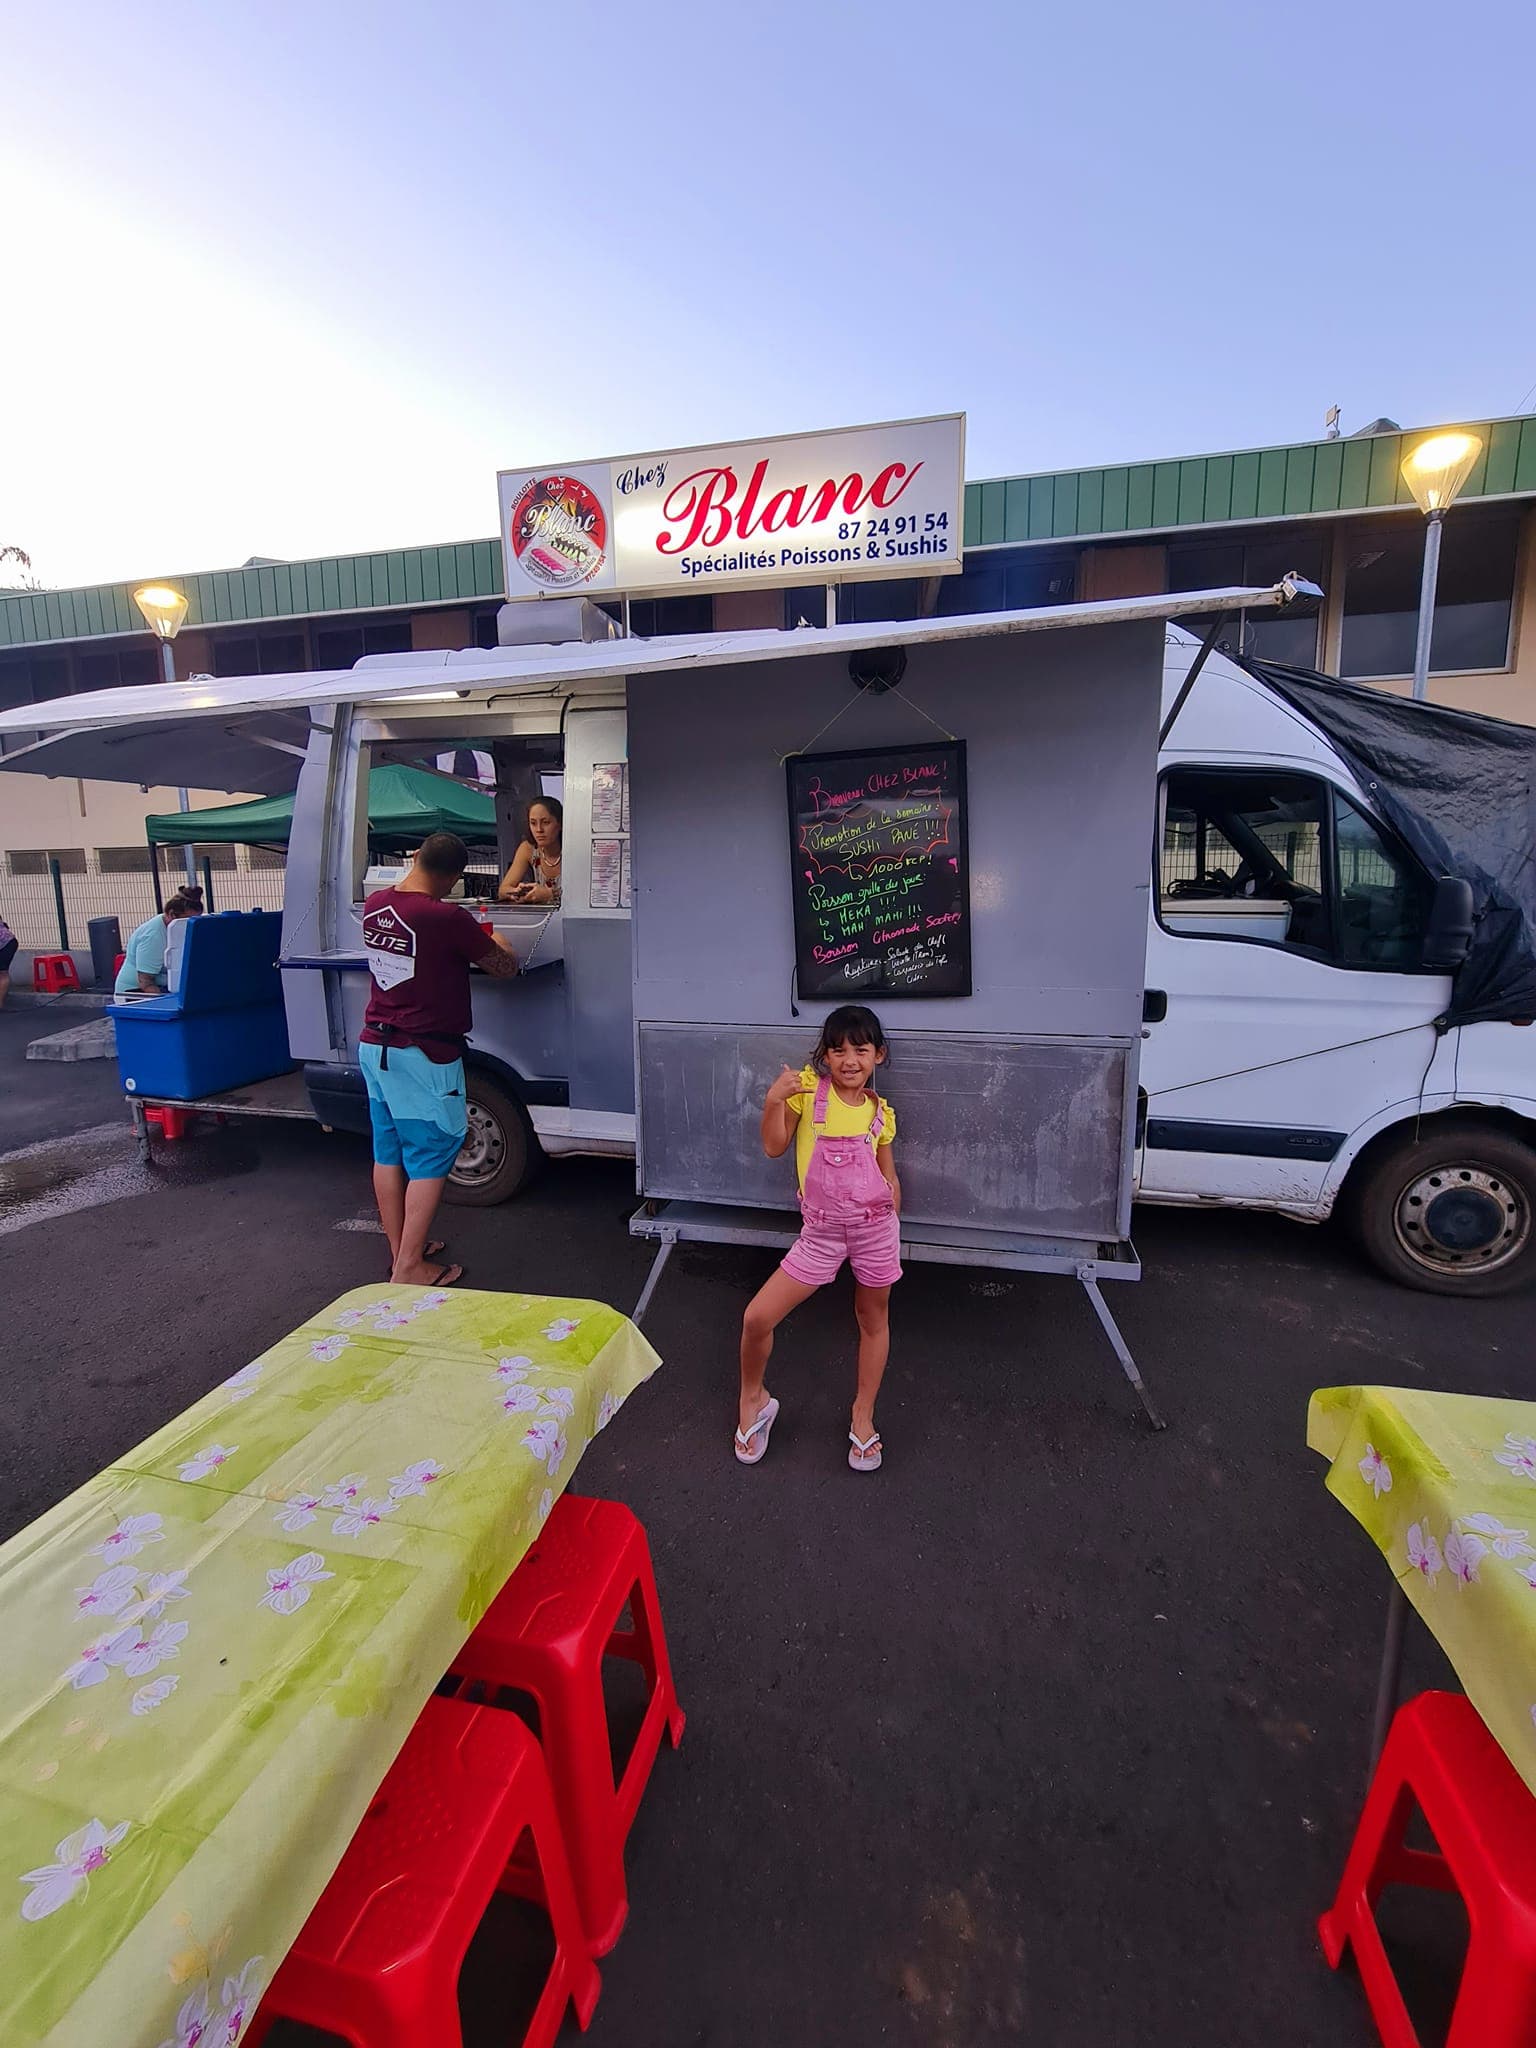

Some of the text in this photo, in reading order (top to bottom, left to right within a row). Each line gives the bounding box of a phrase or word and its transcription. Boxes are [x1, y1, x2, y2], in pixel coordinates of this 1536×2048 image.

[511, 477, 537, 510] ROULOTTE
[616, 460, 669, 496] Chez
[521, 504, 597, 537] Blanc
[655, 458, 926, 555] Blanc
[838, 512, 949, 540] 87 24 91 54
[681, 534, 948, 577] Spécialités Poissons & Sushis
[868, 773, 899, 792] CHEZ
[364, 930, 408, 952] ELITE
